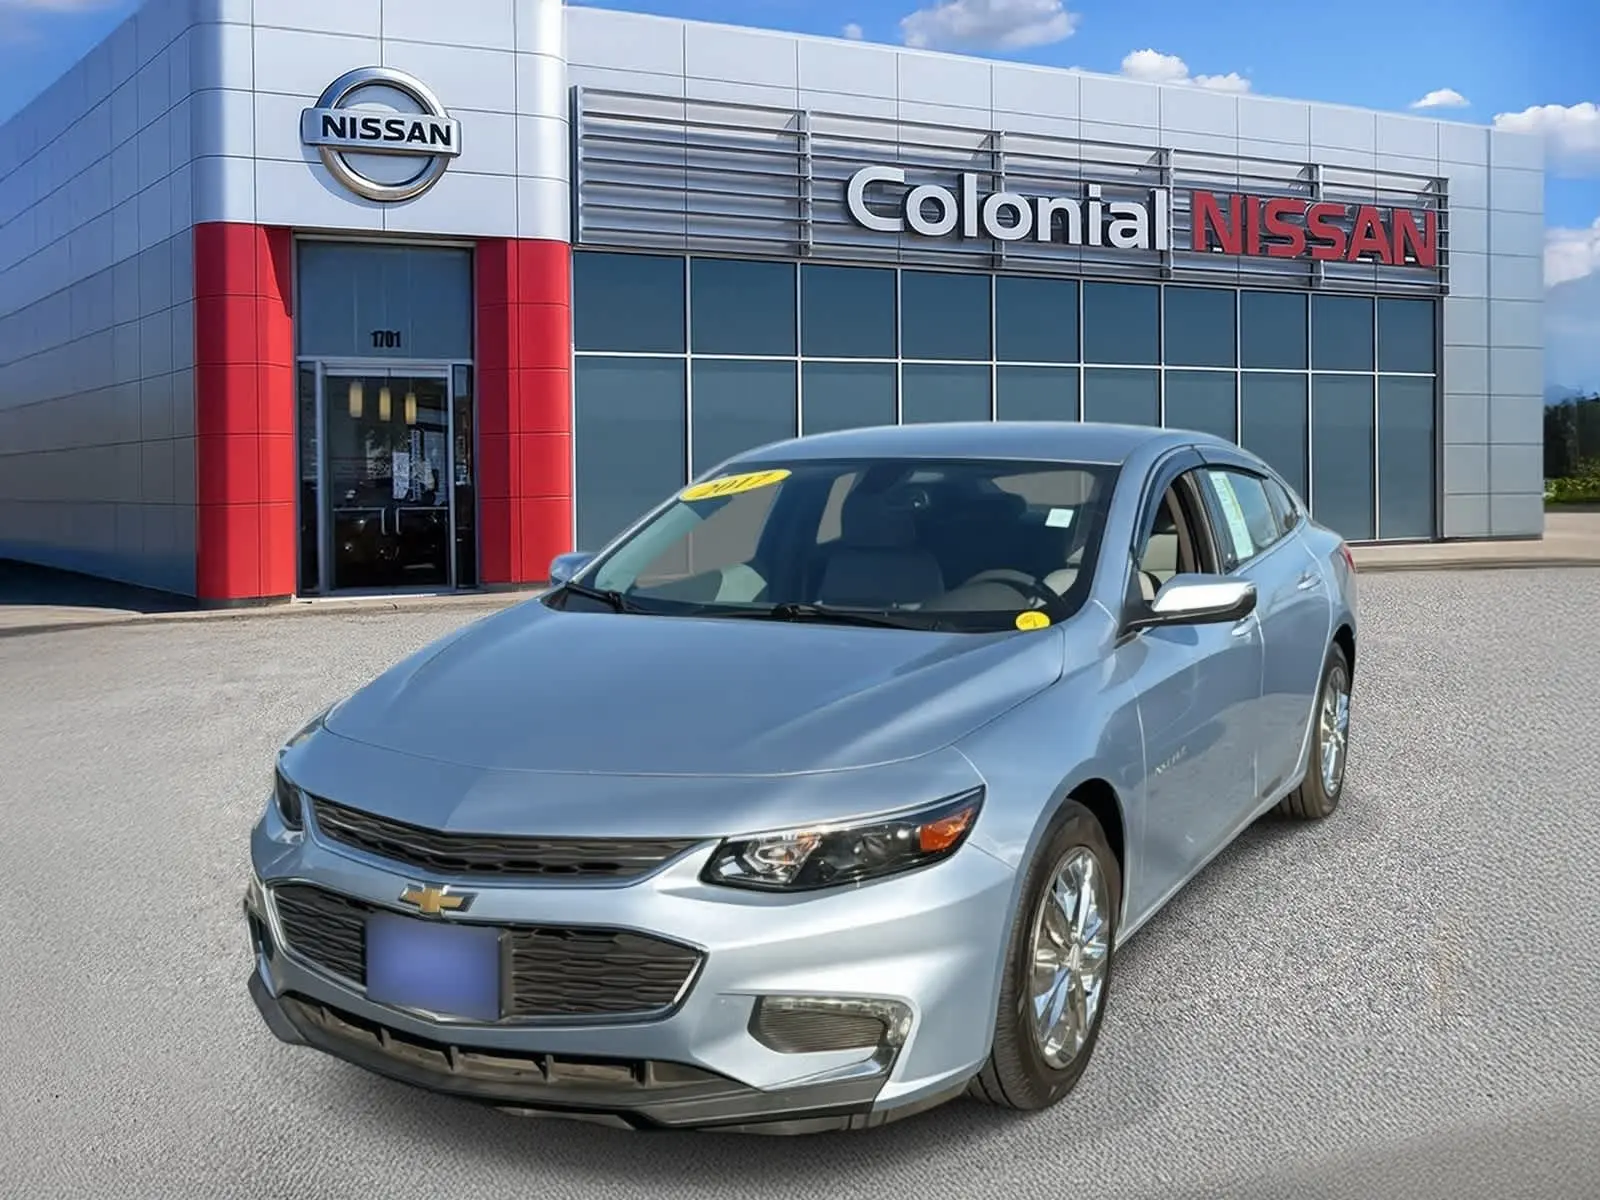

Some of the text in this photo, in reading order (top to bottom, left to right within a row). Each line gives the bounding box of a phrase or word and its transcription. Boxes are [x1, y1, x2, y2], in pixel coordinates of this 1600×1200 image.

[322, 115, 451, 146] NISSAN
[847, 165, 1436, 267] Colonial NISSAN
[370, 330, 401, 348] 1701
